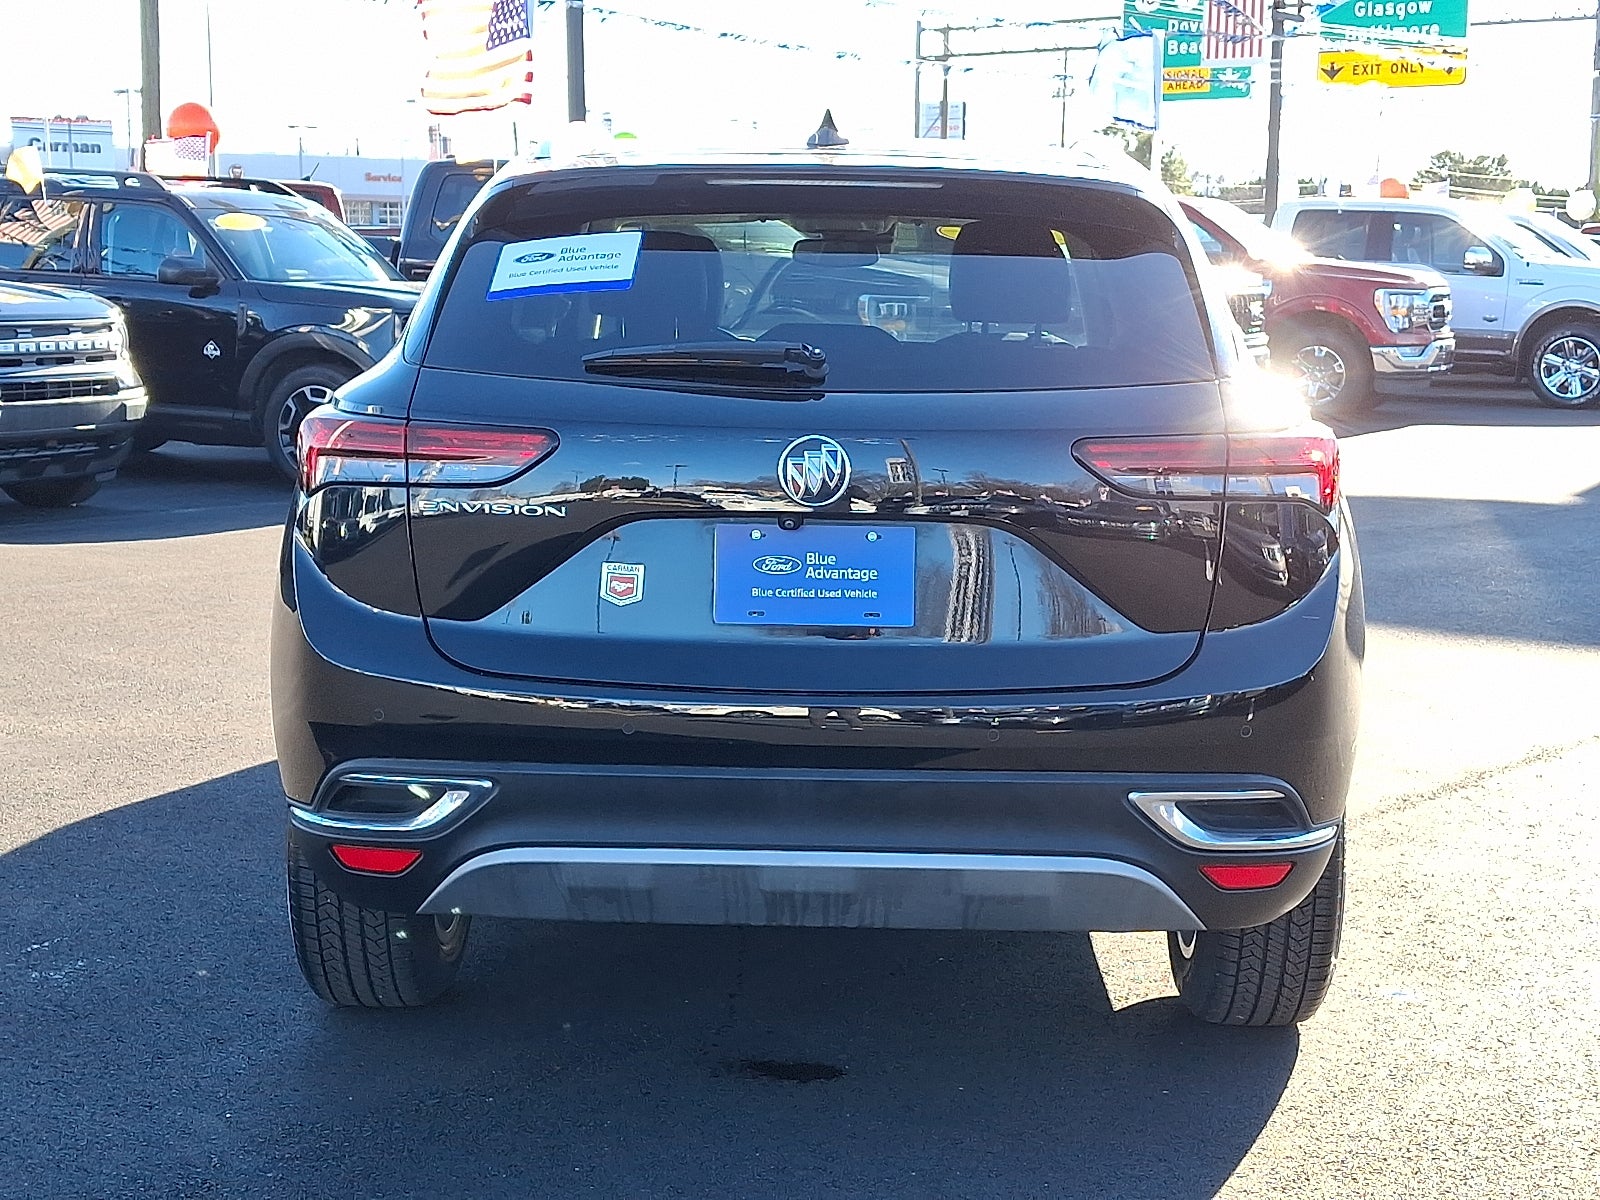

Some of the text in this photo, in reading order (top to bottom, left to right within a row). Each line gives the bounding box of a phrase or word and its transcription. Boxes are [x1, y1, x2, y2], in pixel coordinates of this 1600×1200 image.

[1353, 0, 1434, 20] Glasgow
[1166, 69, 1205, 79] SIGNAL
[1352, 62, 1425, 76] EXIT ONLY
[1166, 80, 1205, 91] AHEAD
[365, 172, 402, 182] Service
[560, 246, 587, 255] Blue
[558, 251, 622, 263] Advantage
[529, 267, 564, 276] Certified
[0, 340, 109, 352] BRONCO
[418, 500, 567, 518] ENVISION
[805, 552, 837, 565] Blue
[606, 564, 640, 573] CARMAN
[805, 566, 878, 582] Advantage
[752, 587, 878, 599] Blue Certified Used Vehicle
